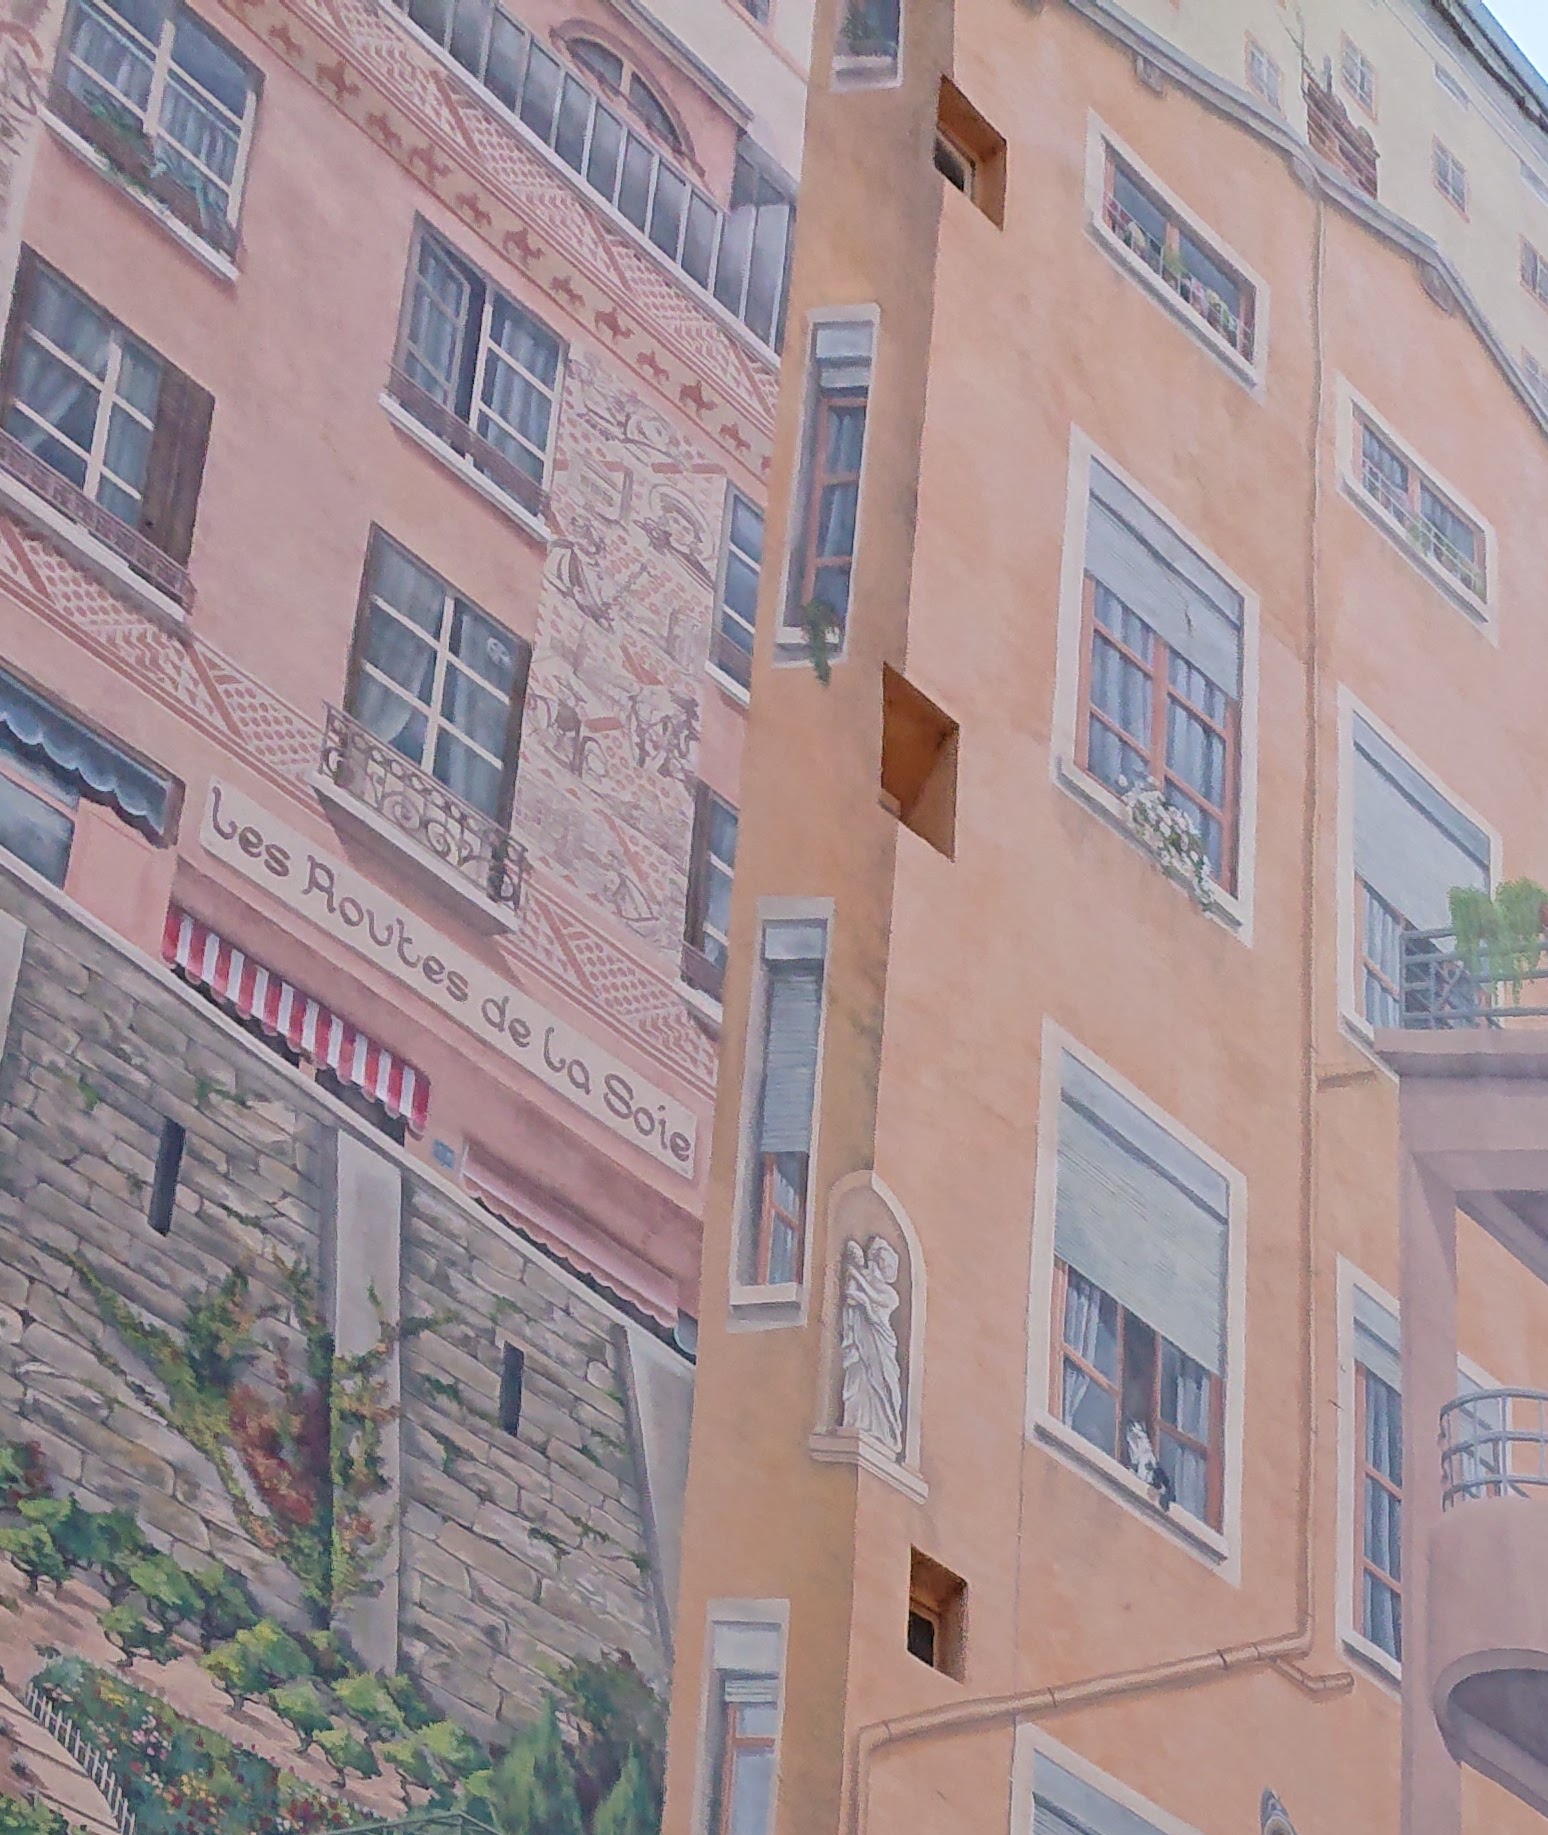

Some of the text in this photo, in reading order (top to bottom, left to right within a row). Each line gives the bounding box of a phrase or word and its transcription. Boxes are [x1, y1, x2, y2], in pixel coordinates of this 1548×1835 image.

[212, 786, 290, 877] Les
[301, 855, 471, 1002] Routes
[481, 995, 533, 1049] de
[602, 1073, 693, 1162] Soie
